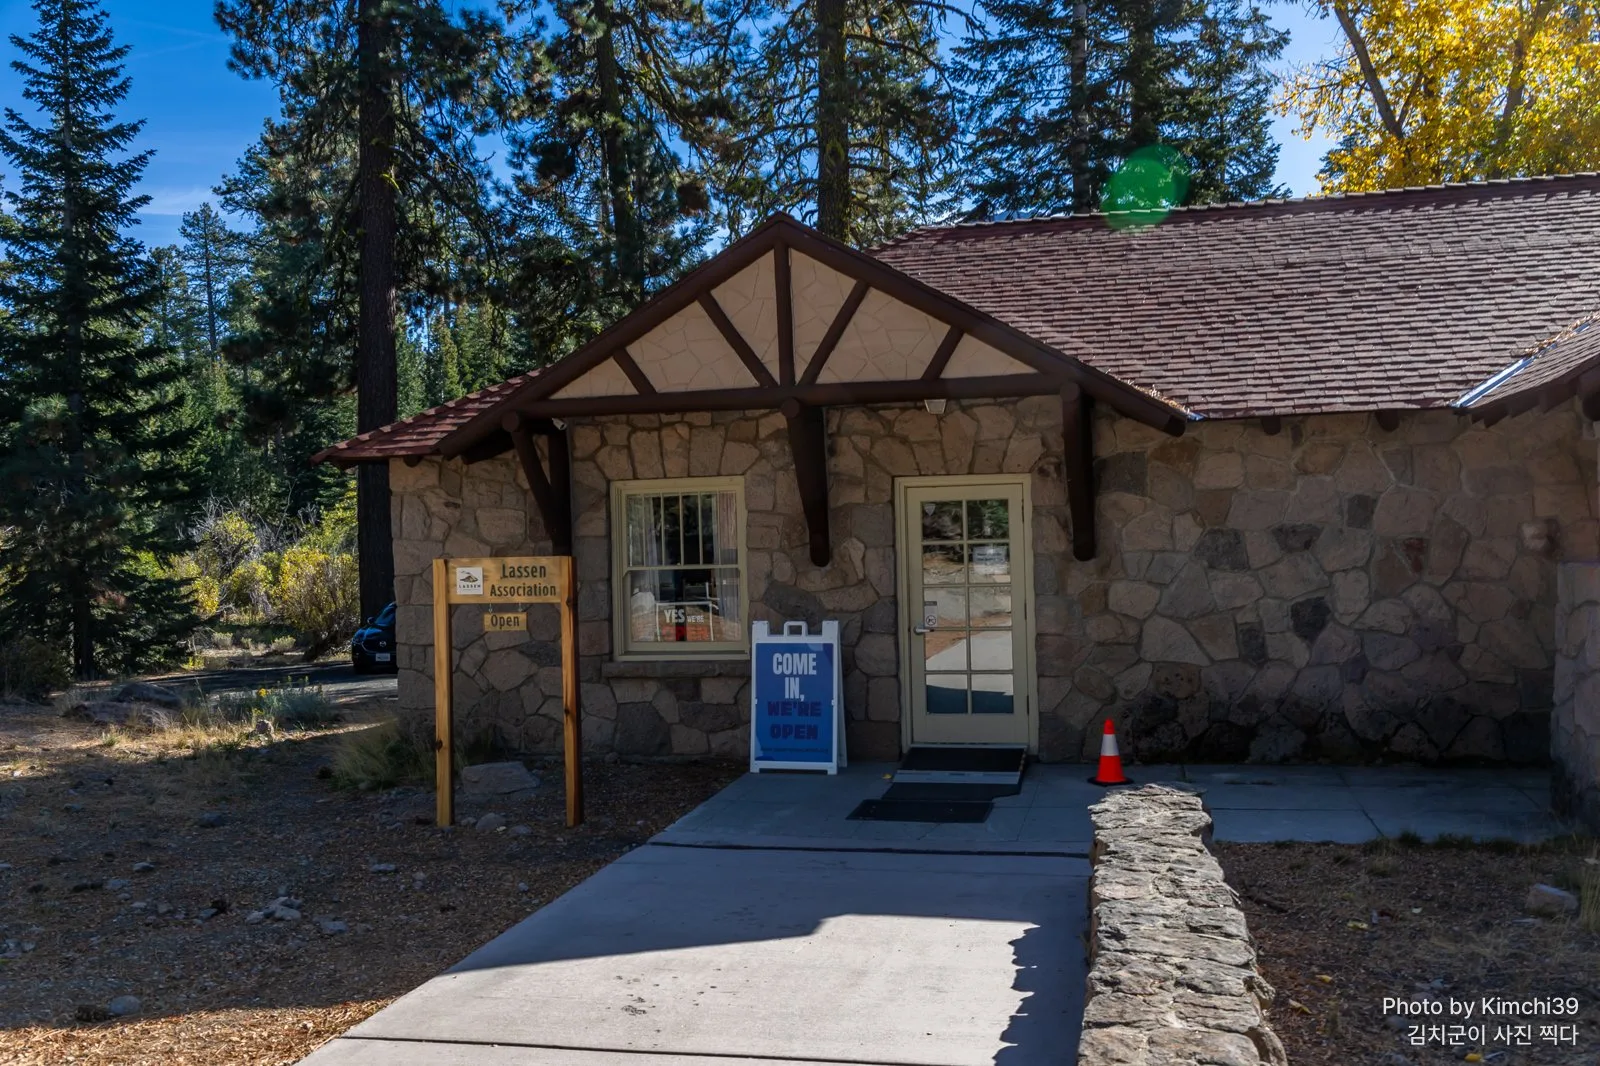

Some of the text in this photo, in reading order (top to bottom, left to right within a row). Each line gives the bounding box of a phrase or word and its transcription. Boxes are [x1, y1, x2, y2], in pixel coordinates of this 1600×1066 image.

[501, 563, 547, 579] Lassen
[490, 582, 557, 597] Association
[490, 614, 520, 629] Open
[663, 609, 685, 624] YES
[772, 653, 817, 676] COME
[784, 676, 805, 702] IN,
[767, 700, 822, 717] WE'RE
[770, 723, 818, 740] OPEN
